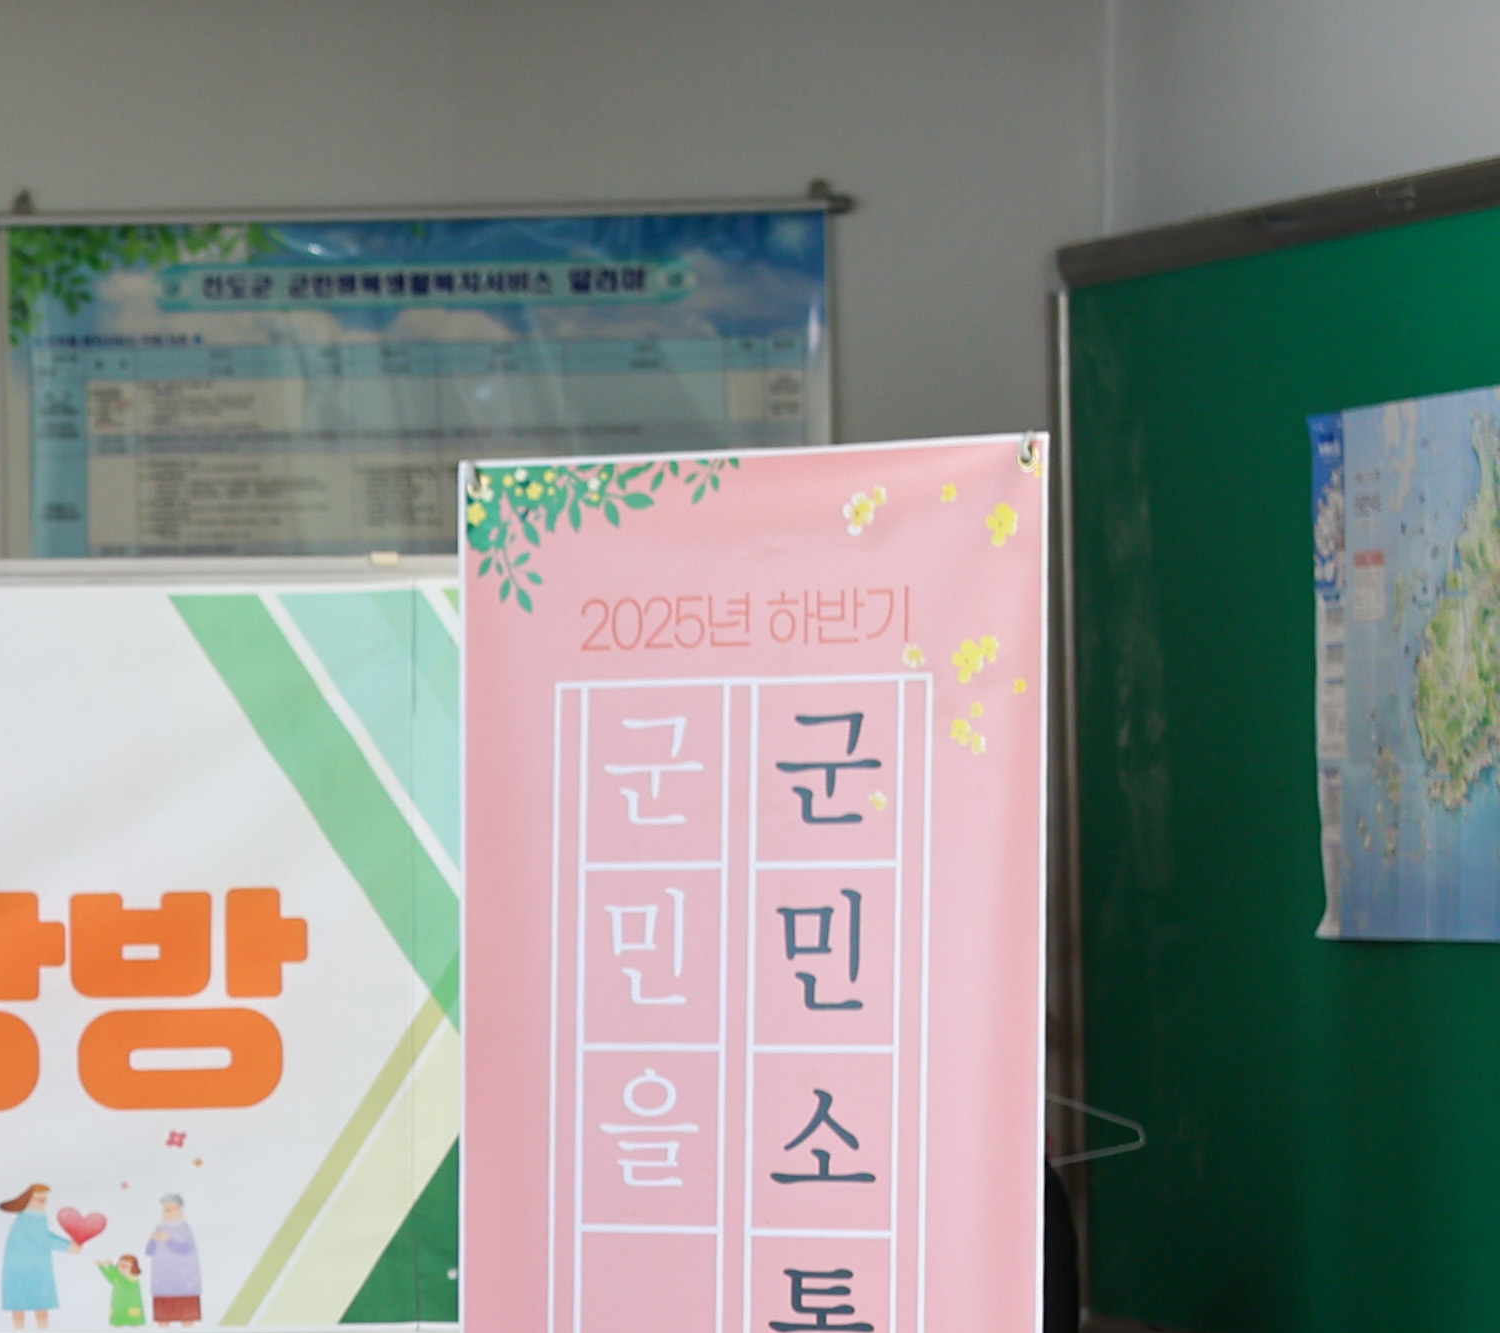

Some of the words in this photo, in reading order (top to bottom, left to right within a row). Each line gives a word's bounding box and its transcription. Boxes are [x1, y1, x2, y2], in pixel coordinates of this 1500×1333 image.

[581, 592, 750, 651] 2025년
[766, 586, 910, 646] 하반기
[599, 716, 704, 1187] 군민을
